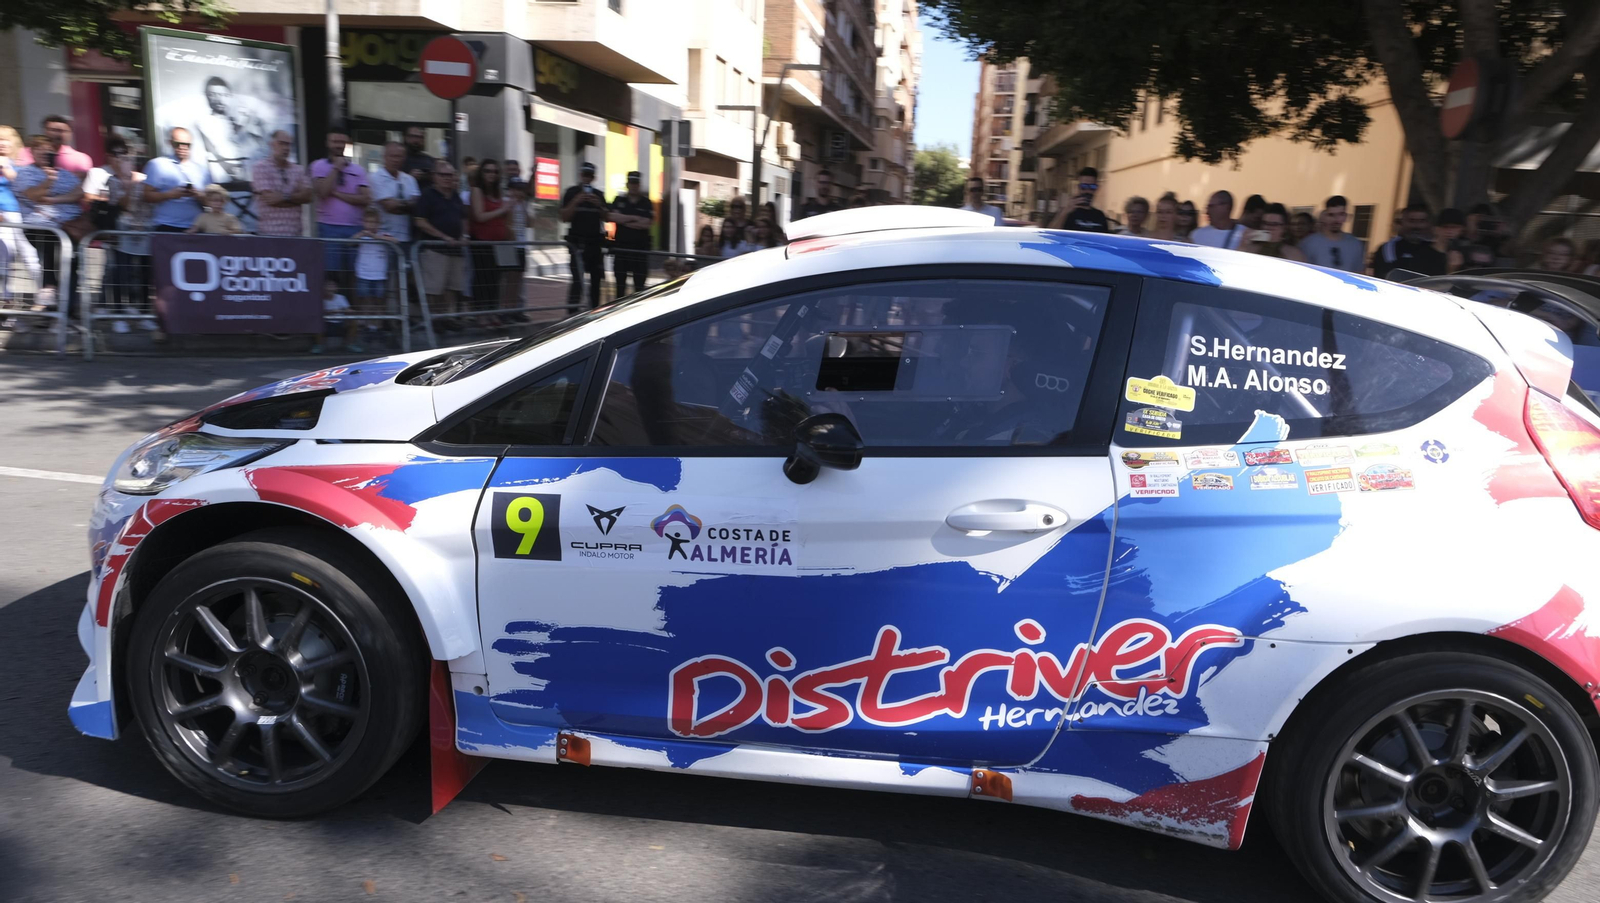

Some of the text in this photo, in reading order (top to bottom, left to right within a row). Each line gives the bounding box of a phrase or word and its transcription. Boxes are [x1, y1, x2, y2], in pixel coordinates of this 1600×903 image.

[219, 255, 297, 277] grupo
[220, 273, 310, 292] control
[1190, 335, 1347, 370] S.Hernandez
[1187, 365, 1328, 395] M.A. Alonso
[1129, 427, 1176, 438] VERIFICADO
[1311, 481, 1353, 492] VERIFICADO
[505, 496, 545, 555] 9
[707, 527, 791, 542] COSTA DE
[570, 541, 643, 552] CUPRA
[579, 551, 635, 560] INDALO MOTOR
[690, 543, 793, 566] ALMERÍA
[667, 617, 1246, 738] Distriver
[979, 686, 1180, 731] Hernandez
